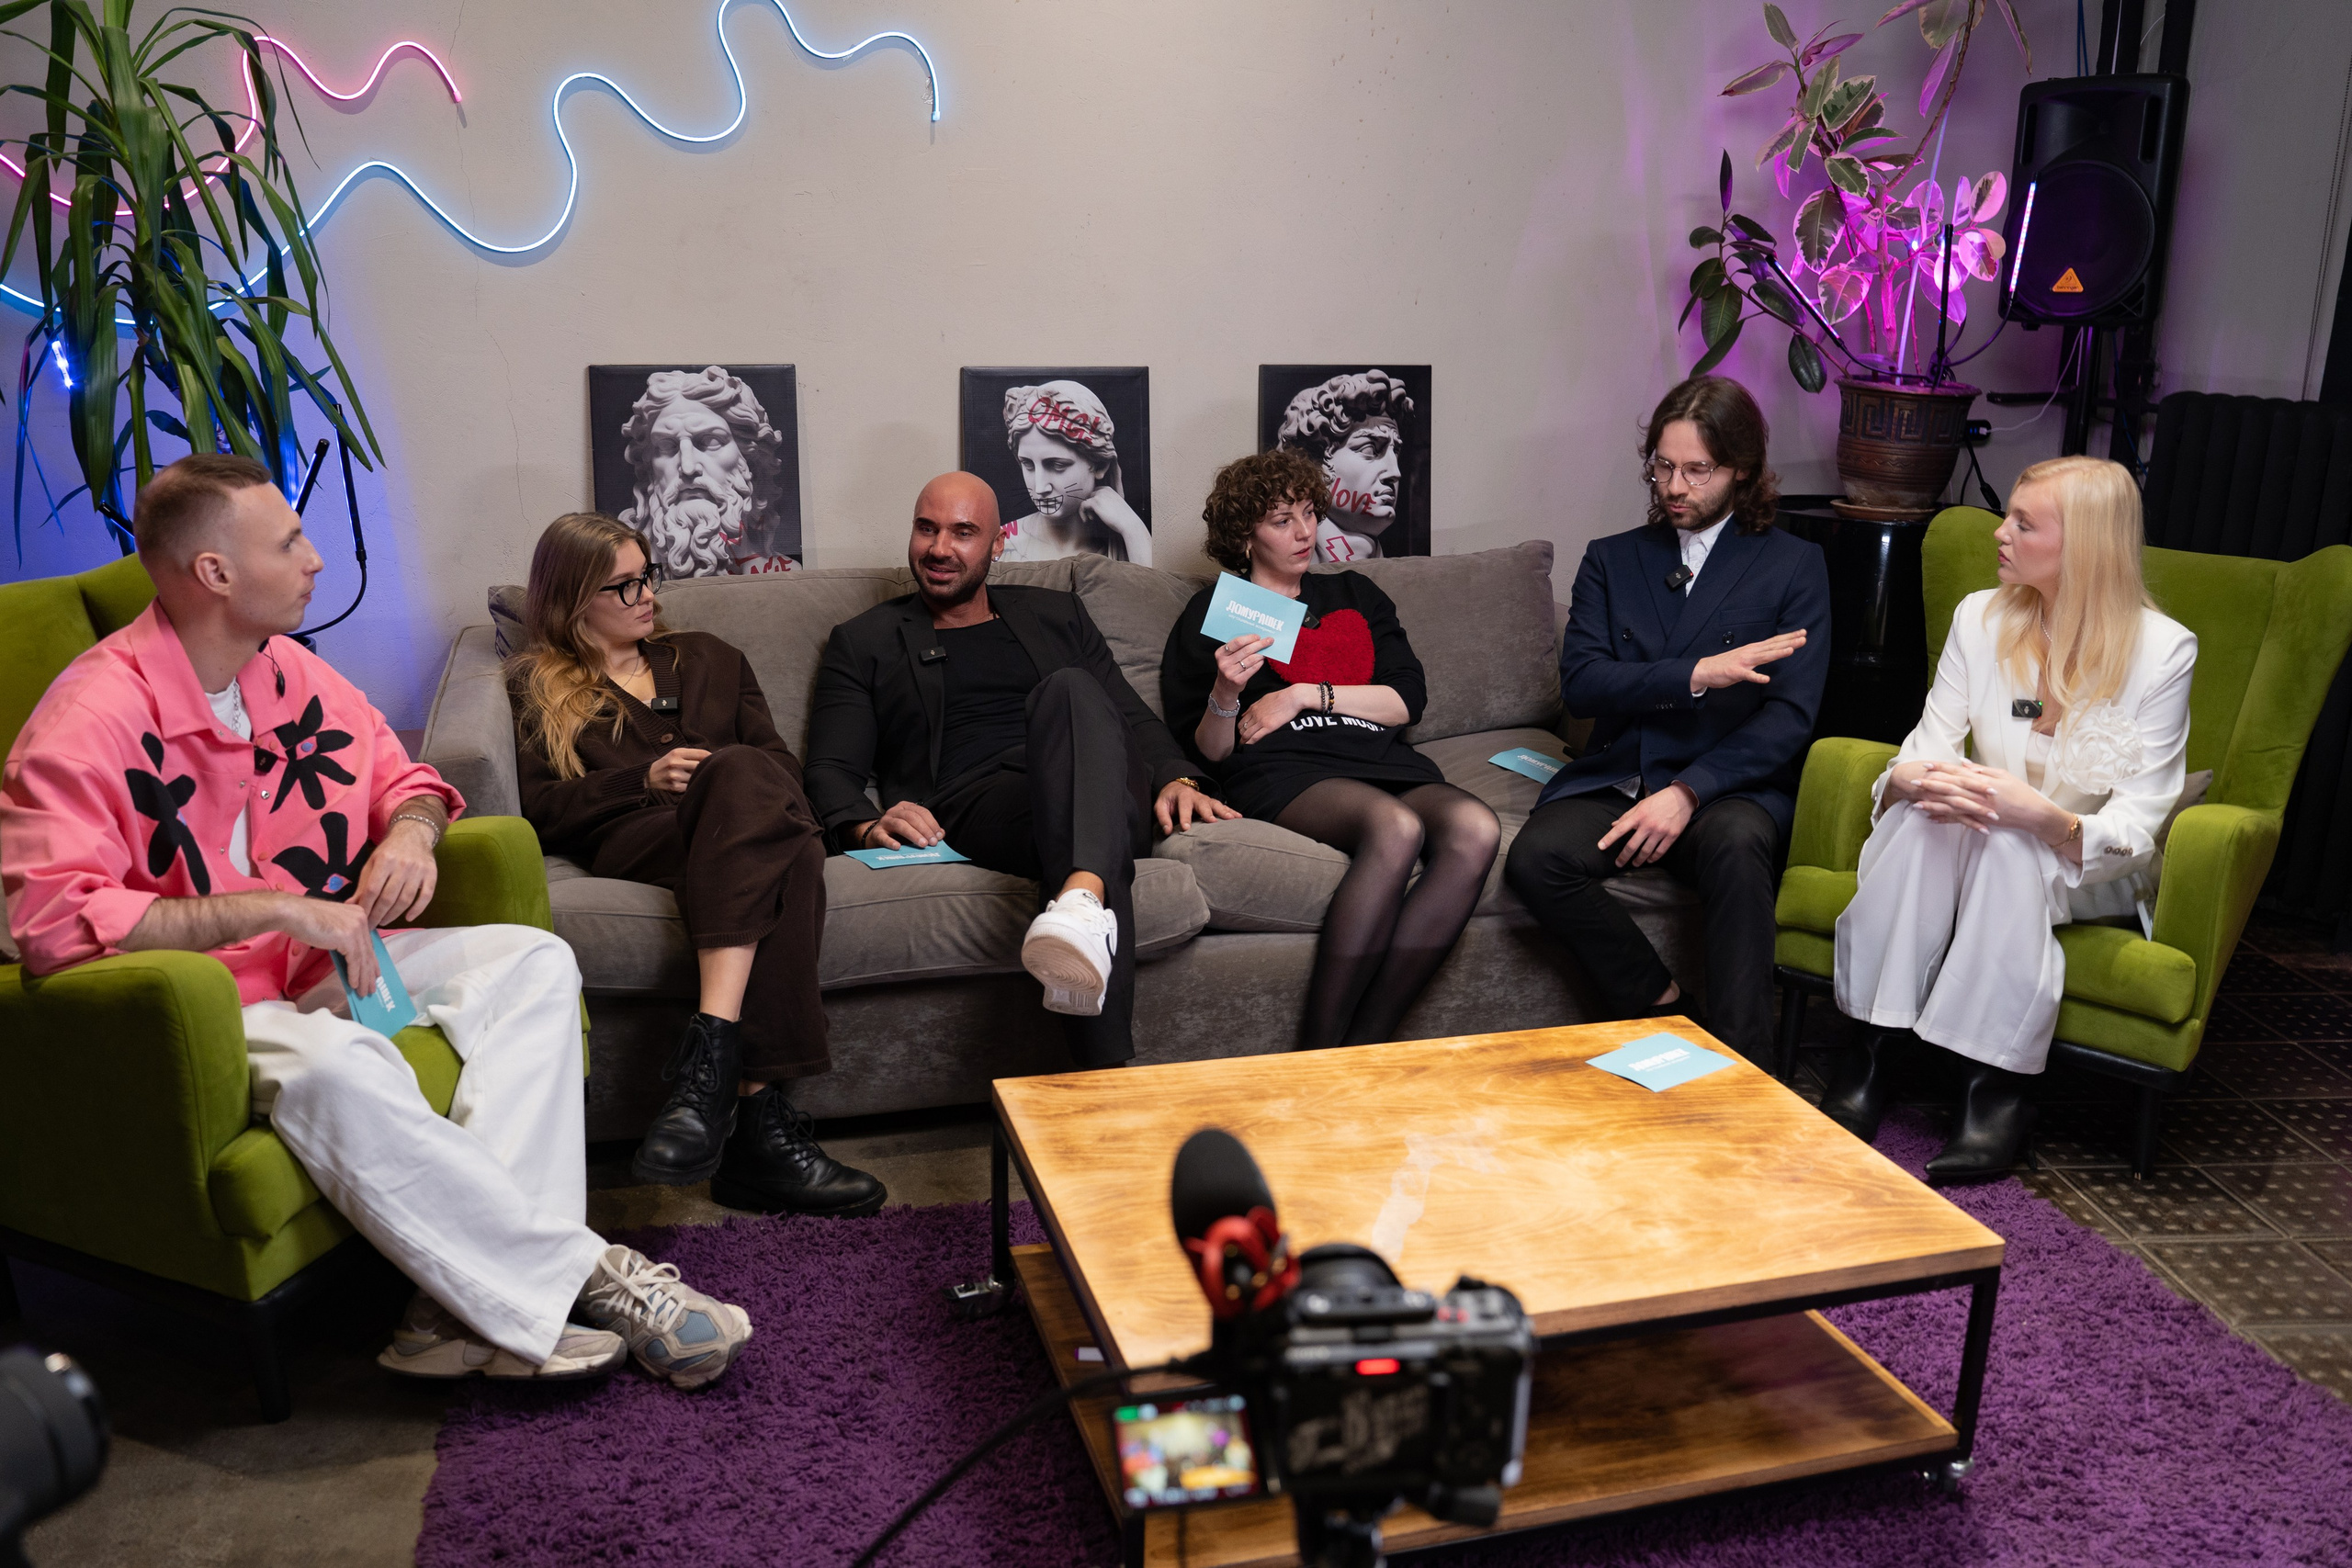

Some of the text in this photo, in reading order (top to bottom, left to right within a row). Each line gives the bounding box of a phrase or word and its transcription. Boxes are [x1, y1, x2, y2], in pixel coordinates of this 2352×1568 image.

[1028, 397, 1100, 445] OMG!
[1226, 600, 1284, 631] ДОМУРАШЕК
[1290, 716, 1338, 731] LOVE
